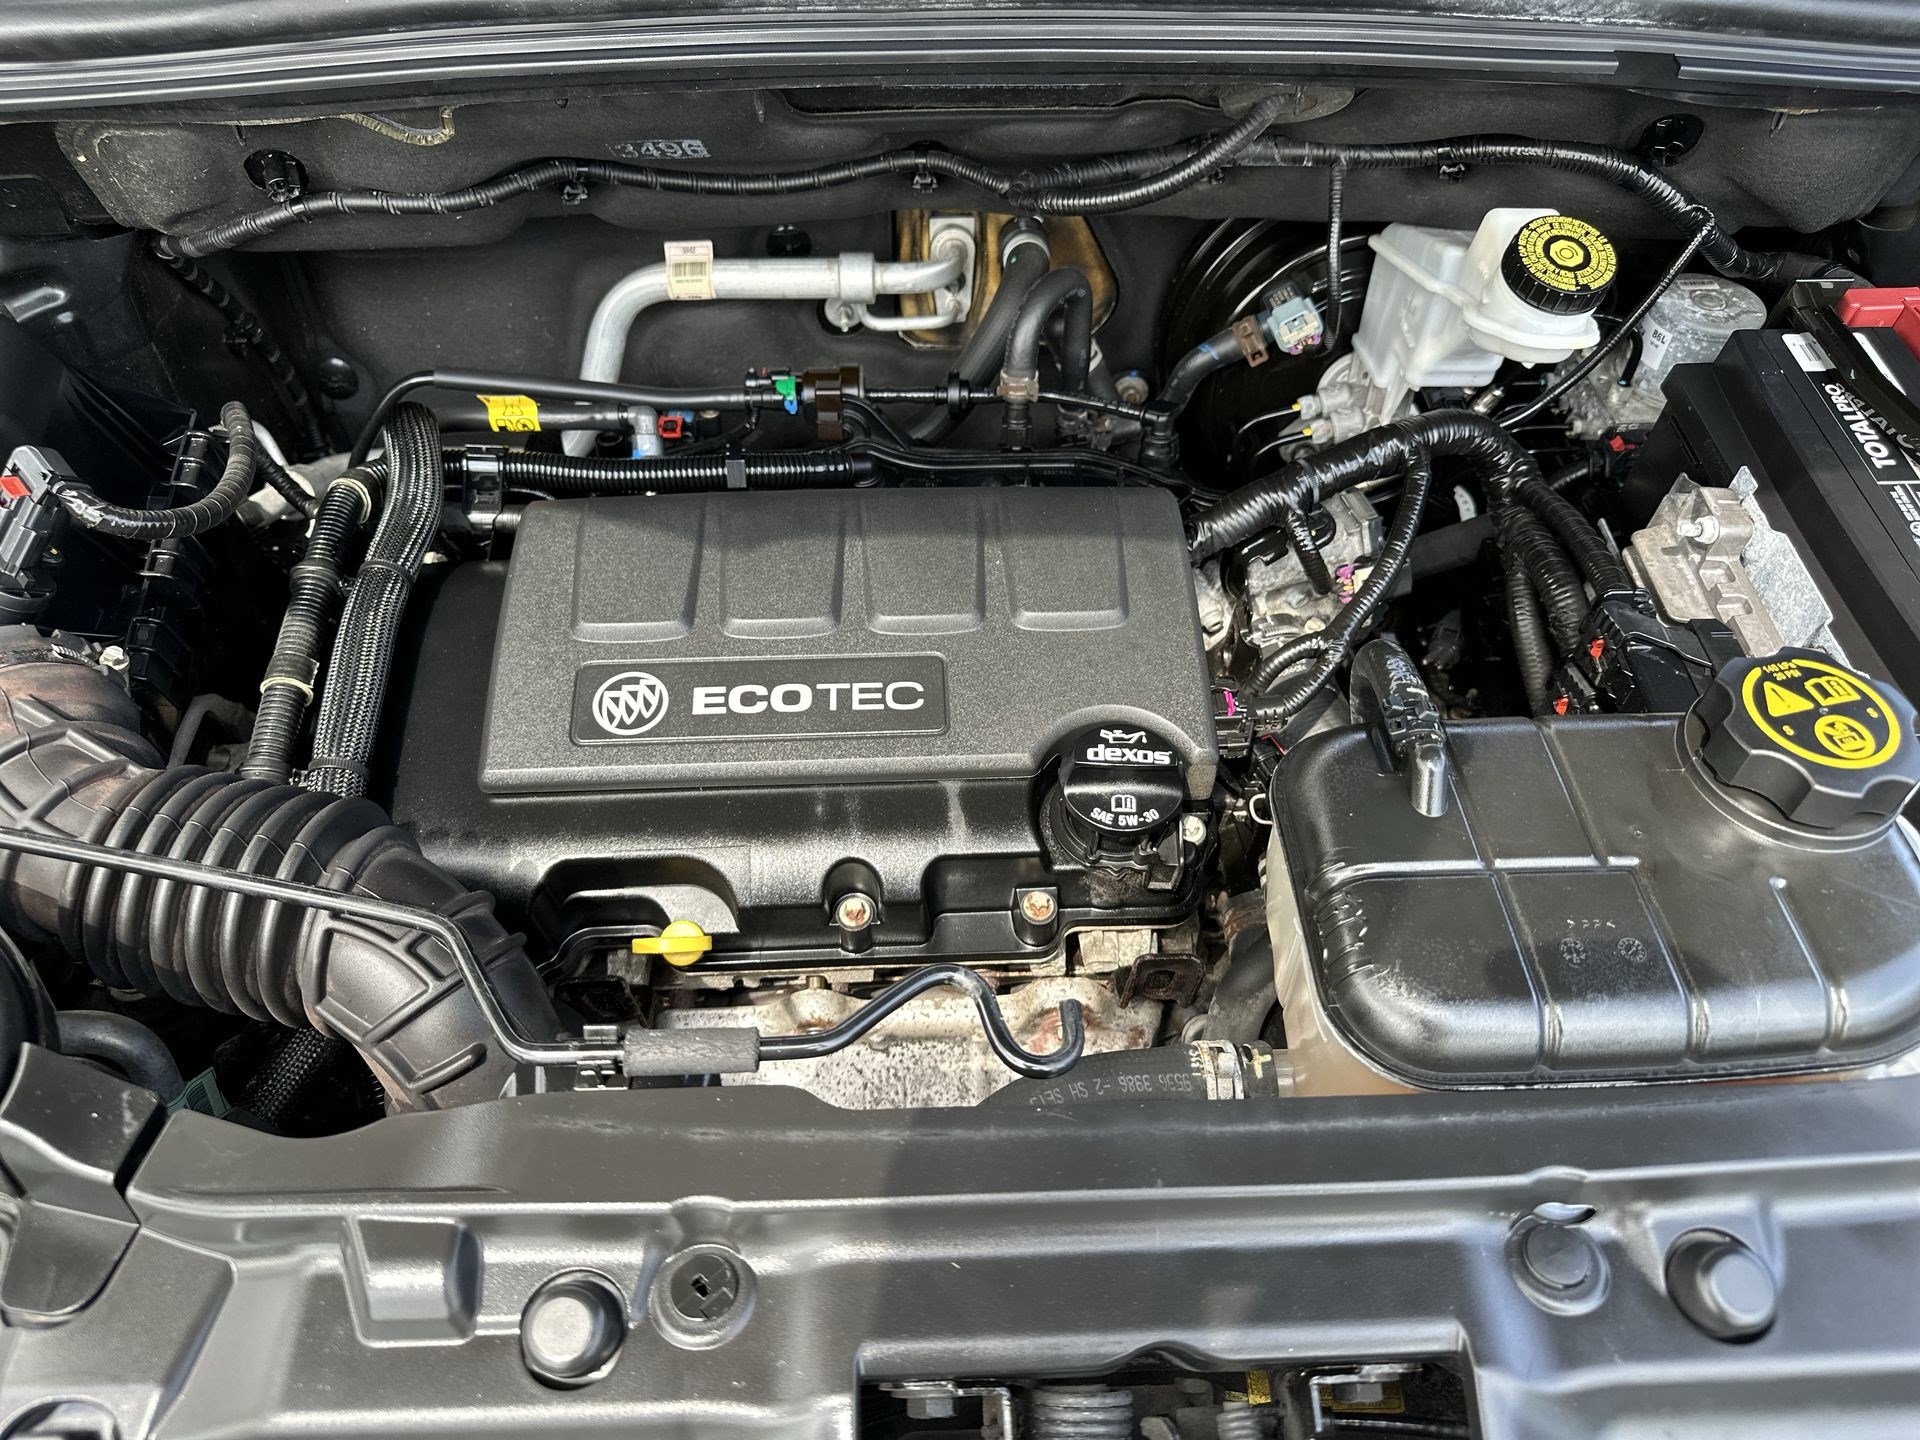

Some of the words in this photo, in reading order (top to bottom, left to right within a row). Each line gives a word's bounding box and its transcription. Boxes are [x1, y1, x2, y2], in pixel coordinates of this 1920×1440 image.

[1651, 329, 1666, 344] B6L
[1822, 383, 1897, 469] TOTALPRO
[691, 681, 925, 715] ECOTEC
[1087, 744, 1171, 765] dexos
[1090, 807, 1115, 825] SAE
[1118, 808, 1160, 827] 5W-30
[1068, 1081, 1089, 1101] SH
[1117, 1074, 1153, 1093] 3986
